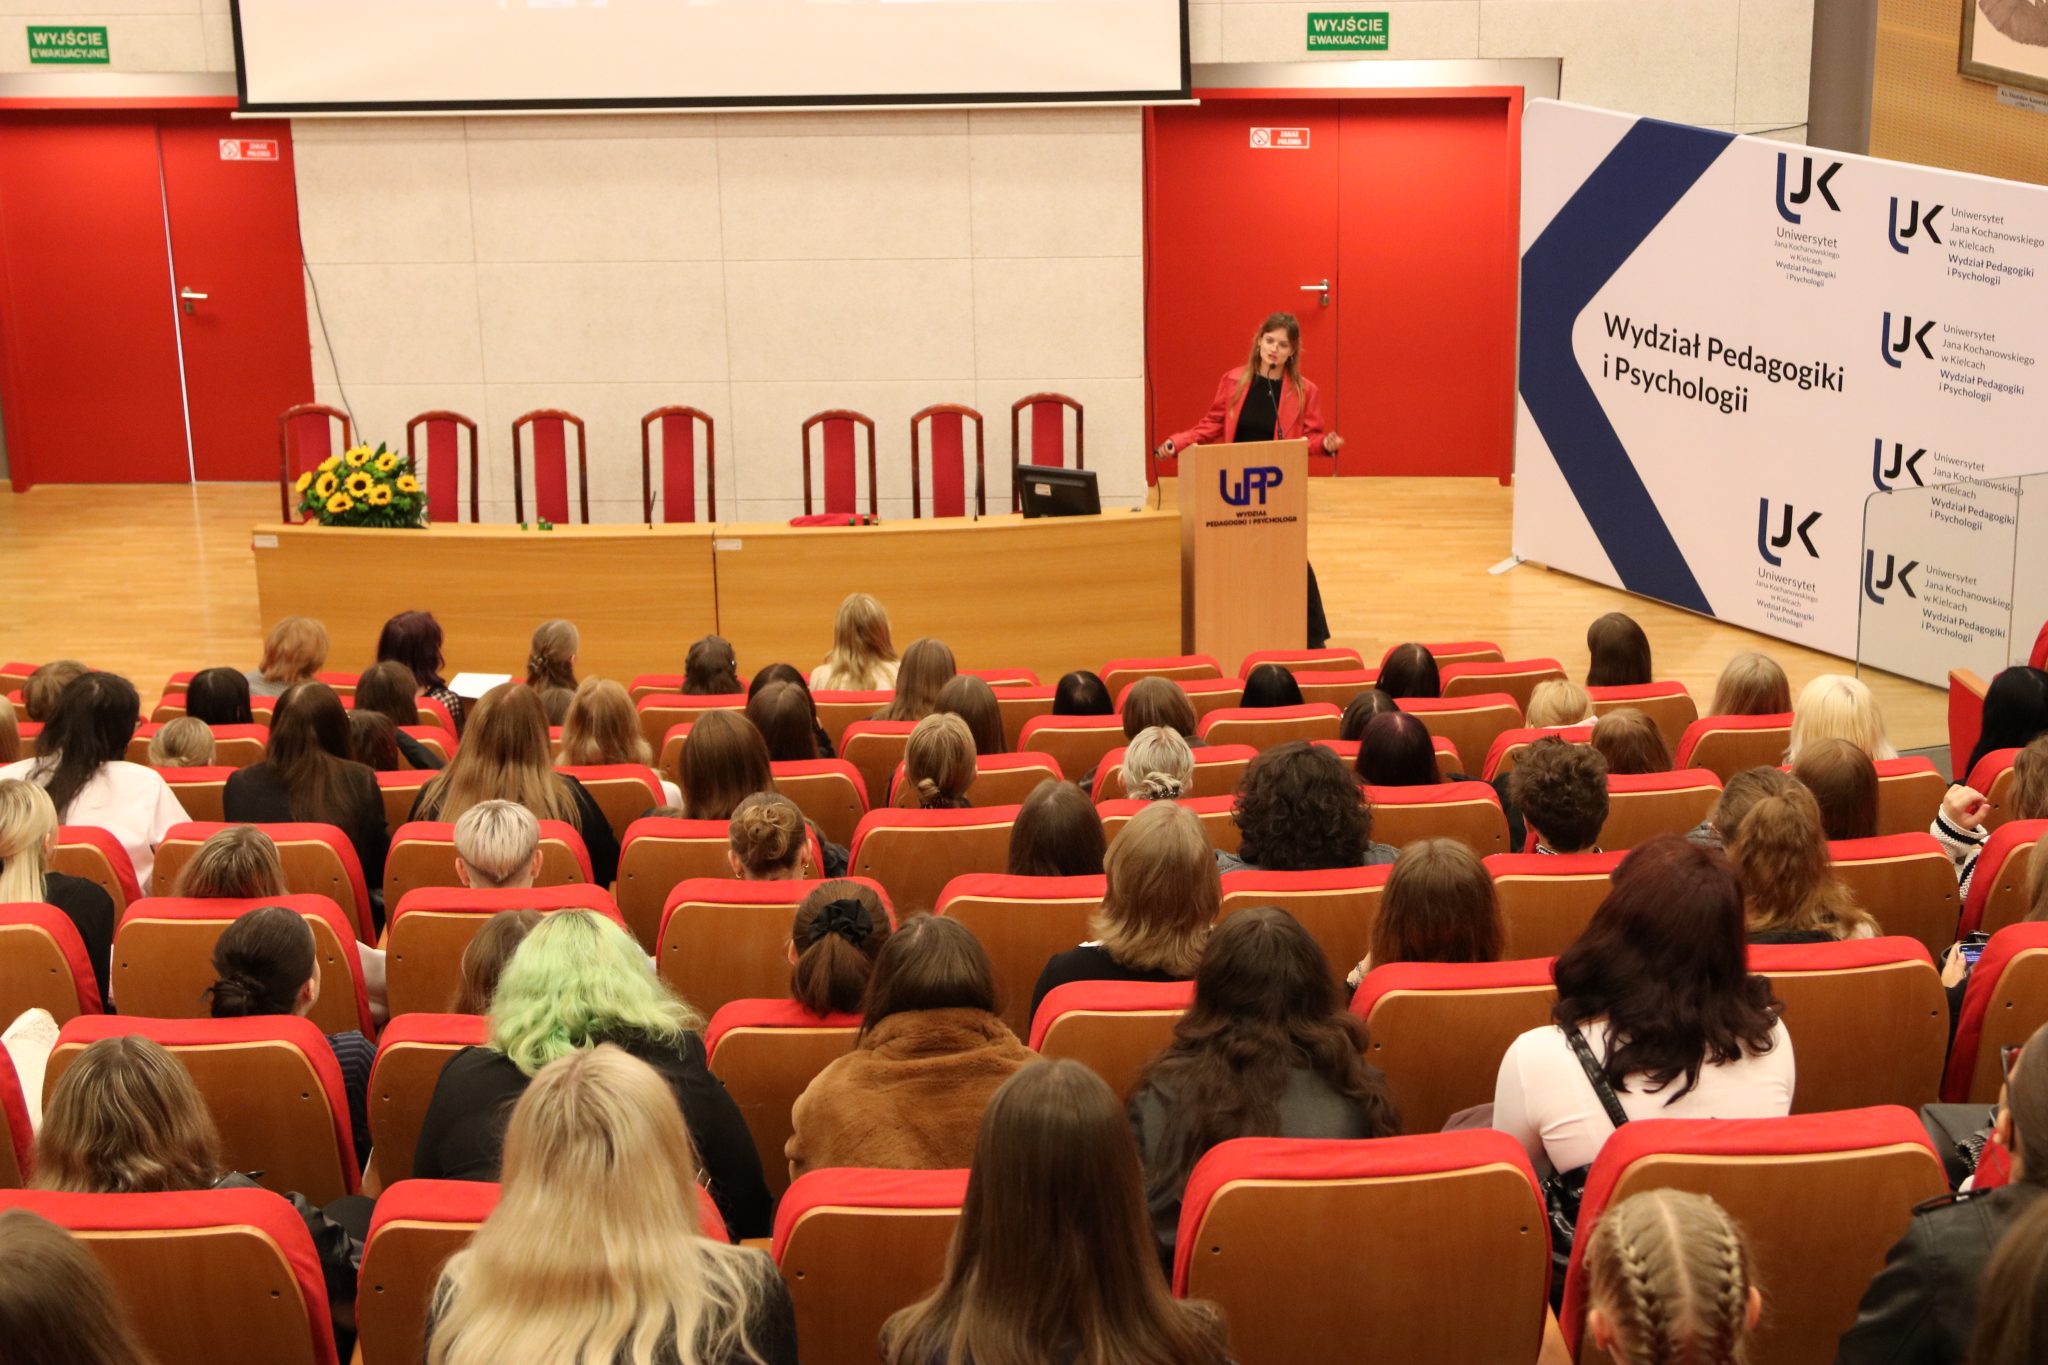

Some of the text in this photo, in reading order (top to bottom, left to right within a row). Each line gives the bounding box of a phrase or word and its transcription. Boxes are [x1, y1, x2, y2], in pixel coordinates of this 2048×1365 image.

[1314, 16, 1383, 32] WYJŚCIE
[33, 29, 102, 46] WYJŚCIE
[1309, 35, 1386, 45] EWAKUACYJNE
[31, 48, 108, 59] EWAKUACYJNE
[1951, 207, 2004, 225] Uniwersytet
[1776, 226, 1837, 248] Uniwersytet
[1950, 223, 2045, 248] Jana Kochanowskiego
[1949, 239, 1995, 254] w Kielcach
[1947, 267, 2001, 286] i Psychologii
[1948, 254, 2034, 278] Wydział Pedagogiki
[1943, 324, 1996, 342] Uniwersytet
[1604, 311, 1844, 392] Wydział Pedagogiki
[1942, 339, 2035, 366] Jana Kochanowskiego
[1941, 355, 1986, 371] w Kielcach
[1603, 353, 1748, 414] i Psychologii
[1939, 382, 1992, 403] i Psychologii
[1940, 369, 2025, 395] Wydział Pedagogiki
[1933, 451, 1985, 472] Uniwersytet
[1932, 467, 2024, 497] Jana Kochanowskiego
[1941, 484, 1976, 500] Kielcach
[1236, 510, 1267, 518] WYDZIAŁ
[1930, 509, 1983, 531] i Psychologii
[1931, 496, 2015, 525] Wydział Pedagogiki
[1758, 567, 1816, 593] Uniwersytet
[1925, 579, 1944, 592] Jana
[1926, 564, 1977, 586] Uniwersytet
[1924, 594, 1968, 613] w Kielcach
[1921, 621, 1973, 644] i Psychologii
[1922, 608, 2006, 639] Wydział Pedagogiki
